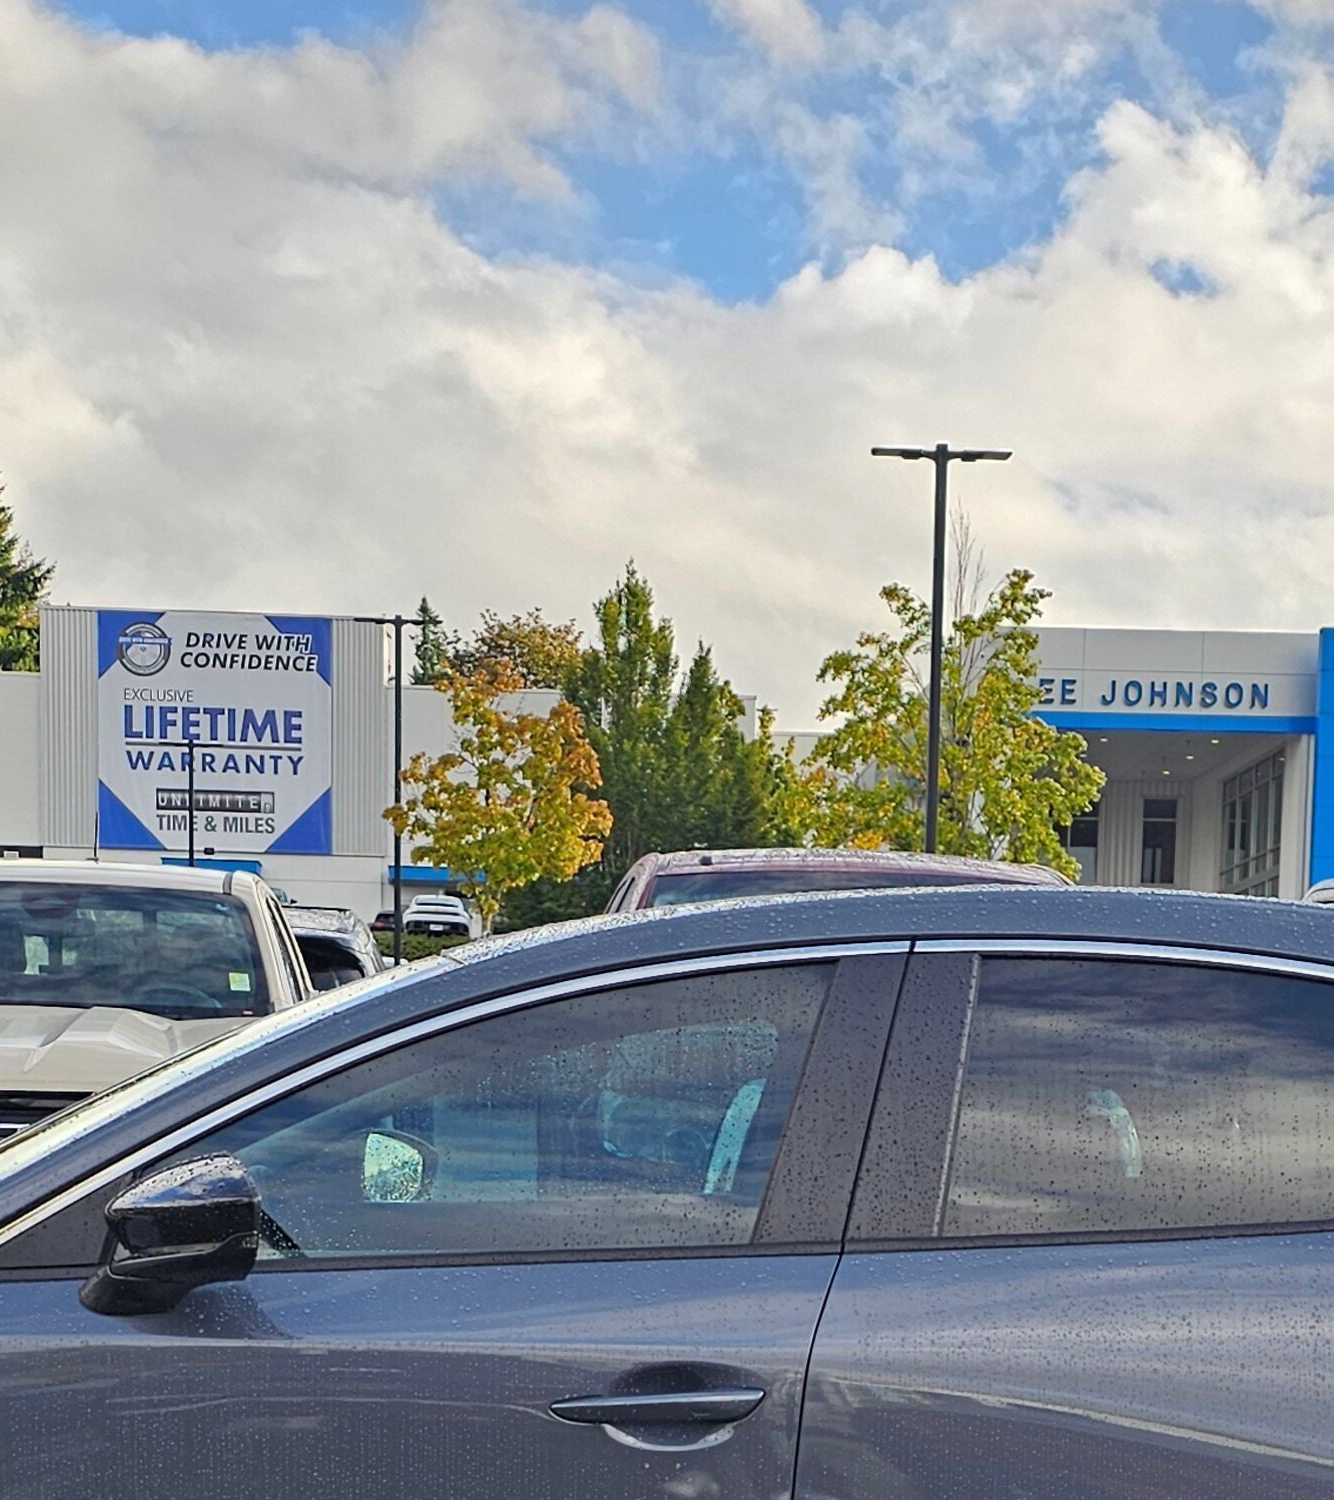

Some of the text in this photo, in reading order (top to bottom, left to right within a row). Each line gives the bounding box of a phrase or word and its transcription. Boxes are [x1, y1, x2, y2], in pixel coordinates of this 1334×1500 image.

[185, 632, 312, 653] DRIVE WITH
[180, 652, 318, 672] CONFIDENCE
[123, 688, 194, 702] EXCLUSIVE
[1038, 678, 1270, 710] EE JOHNSON
[124, 704, 303, 744] LIFETIME
[125, 750, 305, 776] WARRANTY
[204, 815, 217, 832] &
[223, 816, 275, 834] MILES
